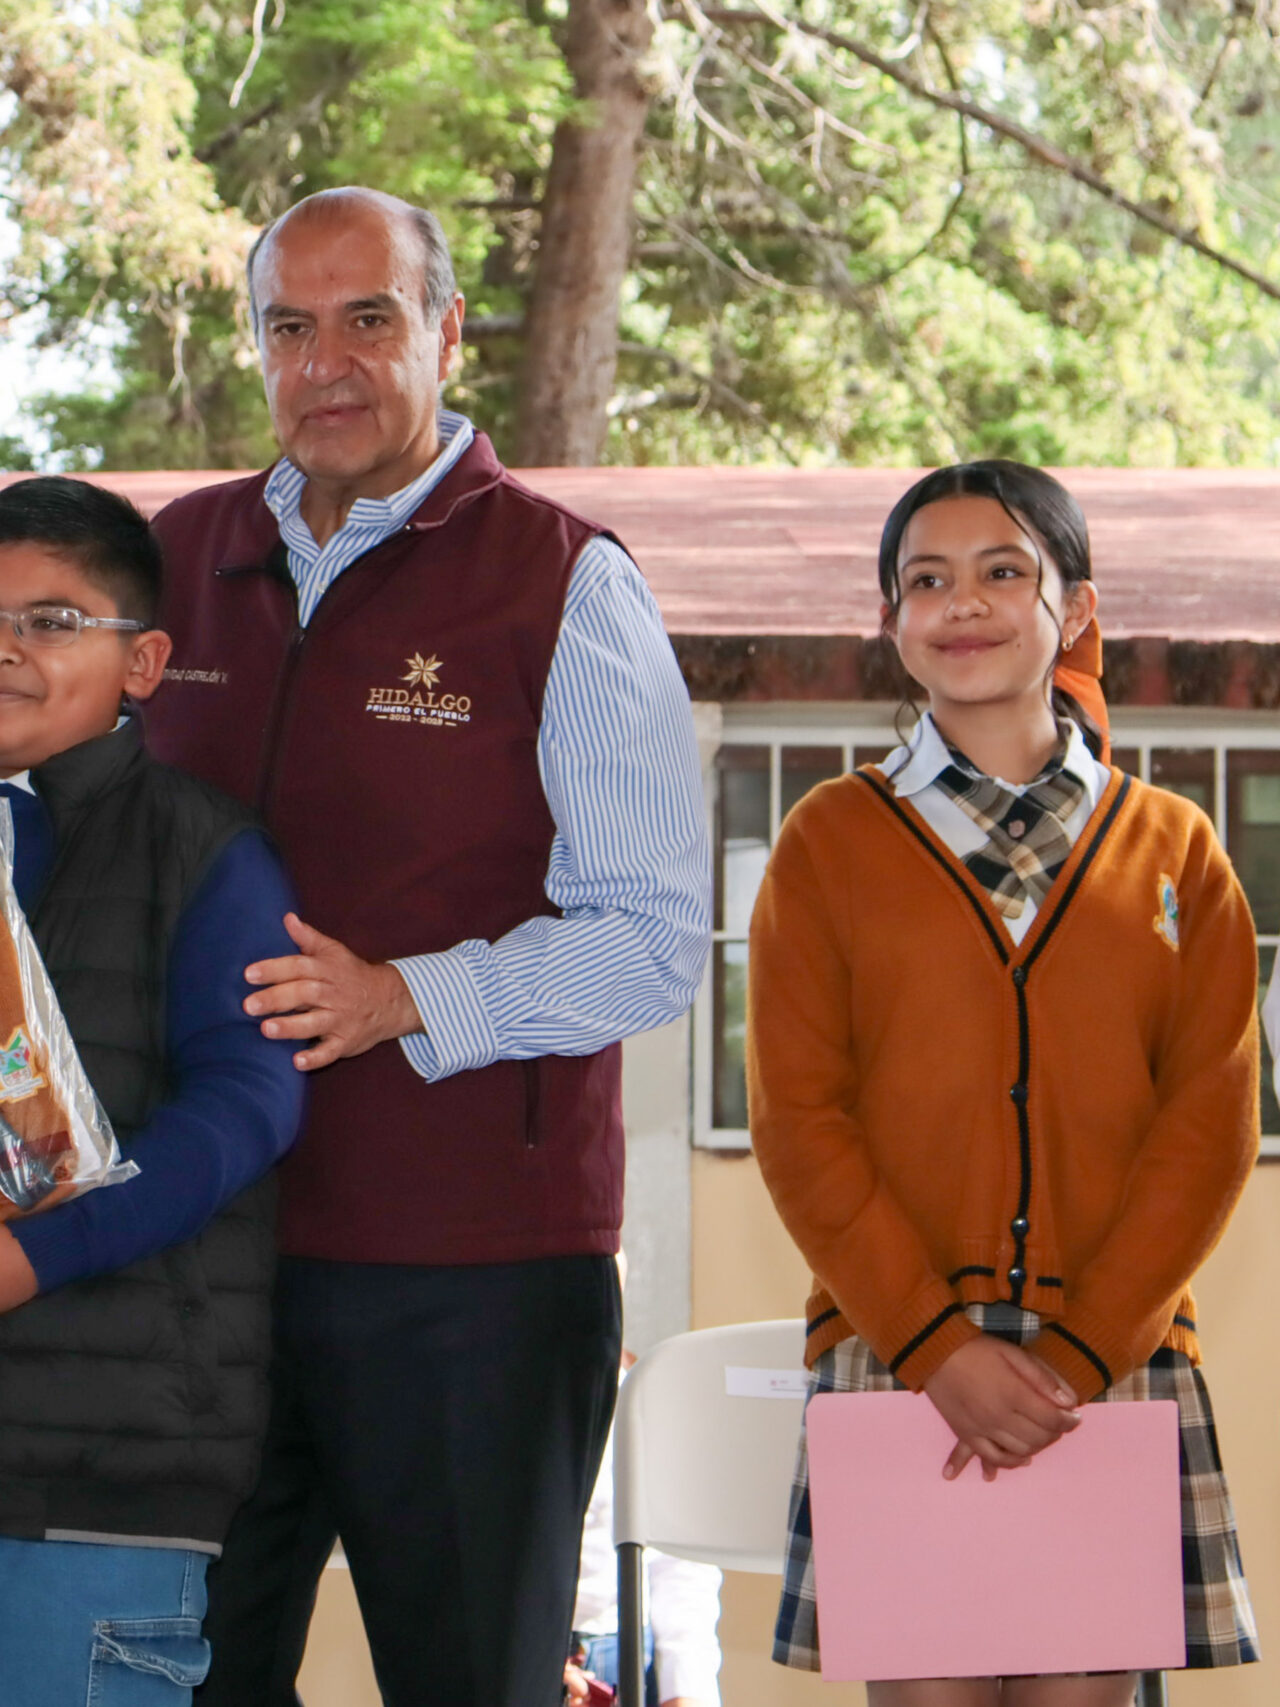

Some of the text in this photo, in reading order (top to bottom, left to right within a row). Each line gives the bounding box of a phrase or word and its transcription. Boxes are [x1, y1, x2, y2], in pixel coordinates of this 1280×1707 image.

[367, 687, 471, 713] HIDALGO
[366, 704, 471, 723] PRIMERO EL PUEBLO
[389, 714, 412, 723] 2022
